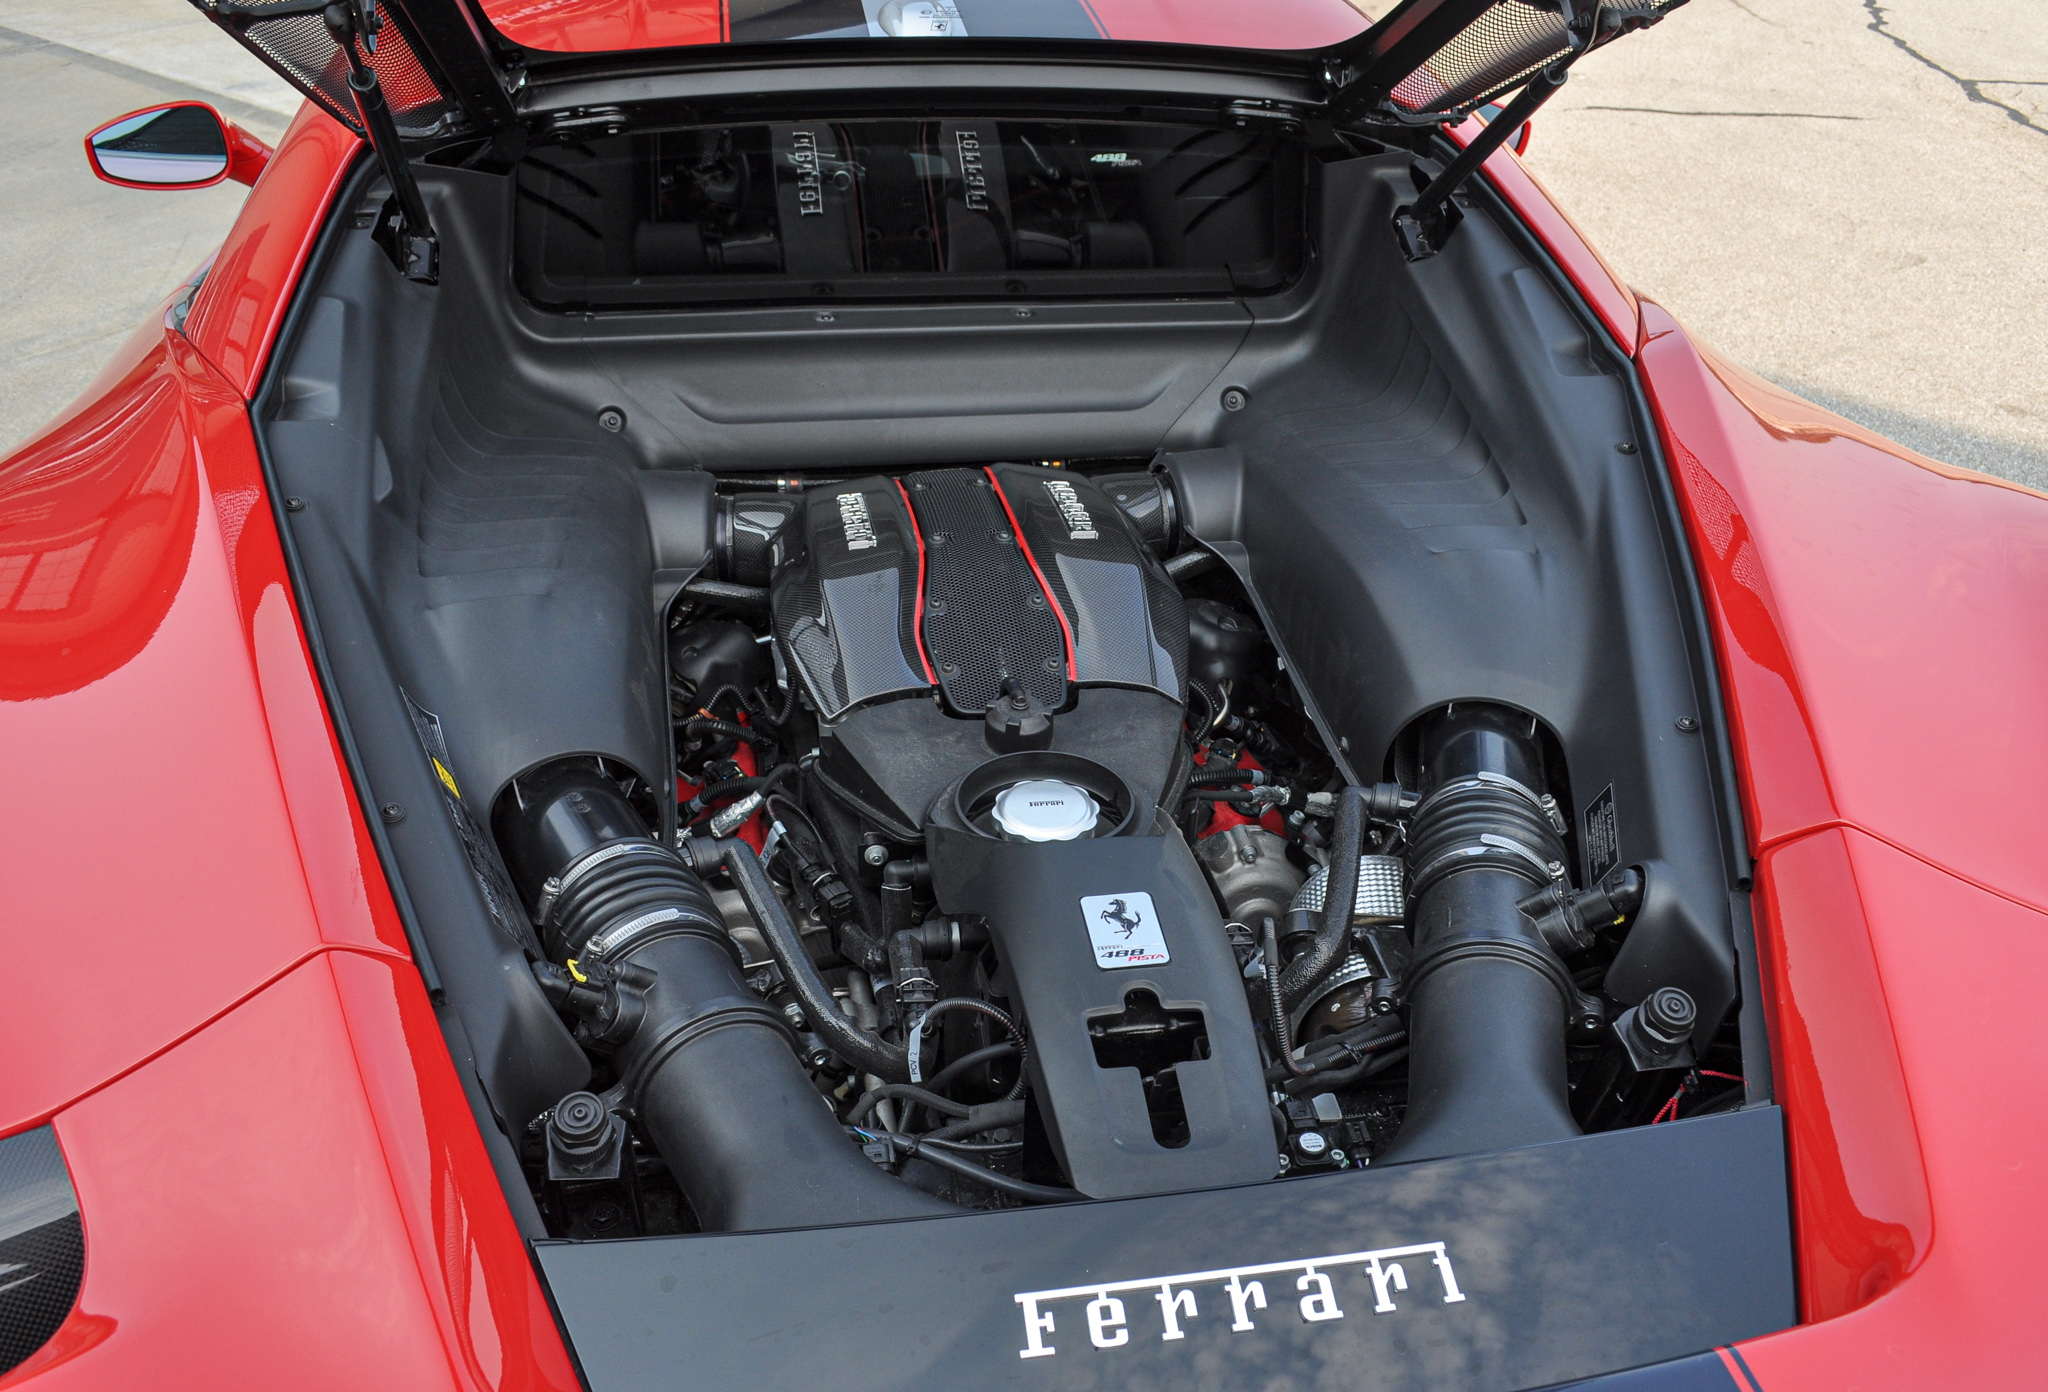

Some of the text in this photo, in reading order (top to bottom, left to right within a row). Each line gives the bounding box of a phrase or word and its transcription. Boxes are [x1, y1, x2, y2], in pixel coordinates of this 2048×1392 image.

[1090, 153, 1127, 163] 488
[1100, 948, 1145, 959] 488
[1128, 953, 1165, 962] PISTA
[910, 1060, 918, 1076] PCV
[1014, 1241, 1466, 1359] Ferrari
